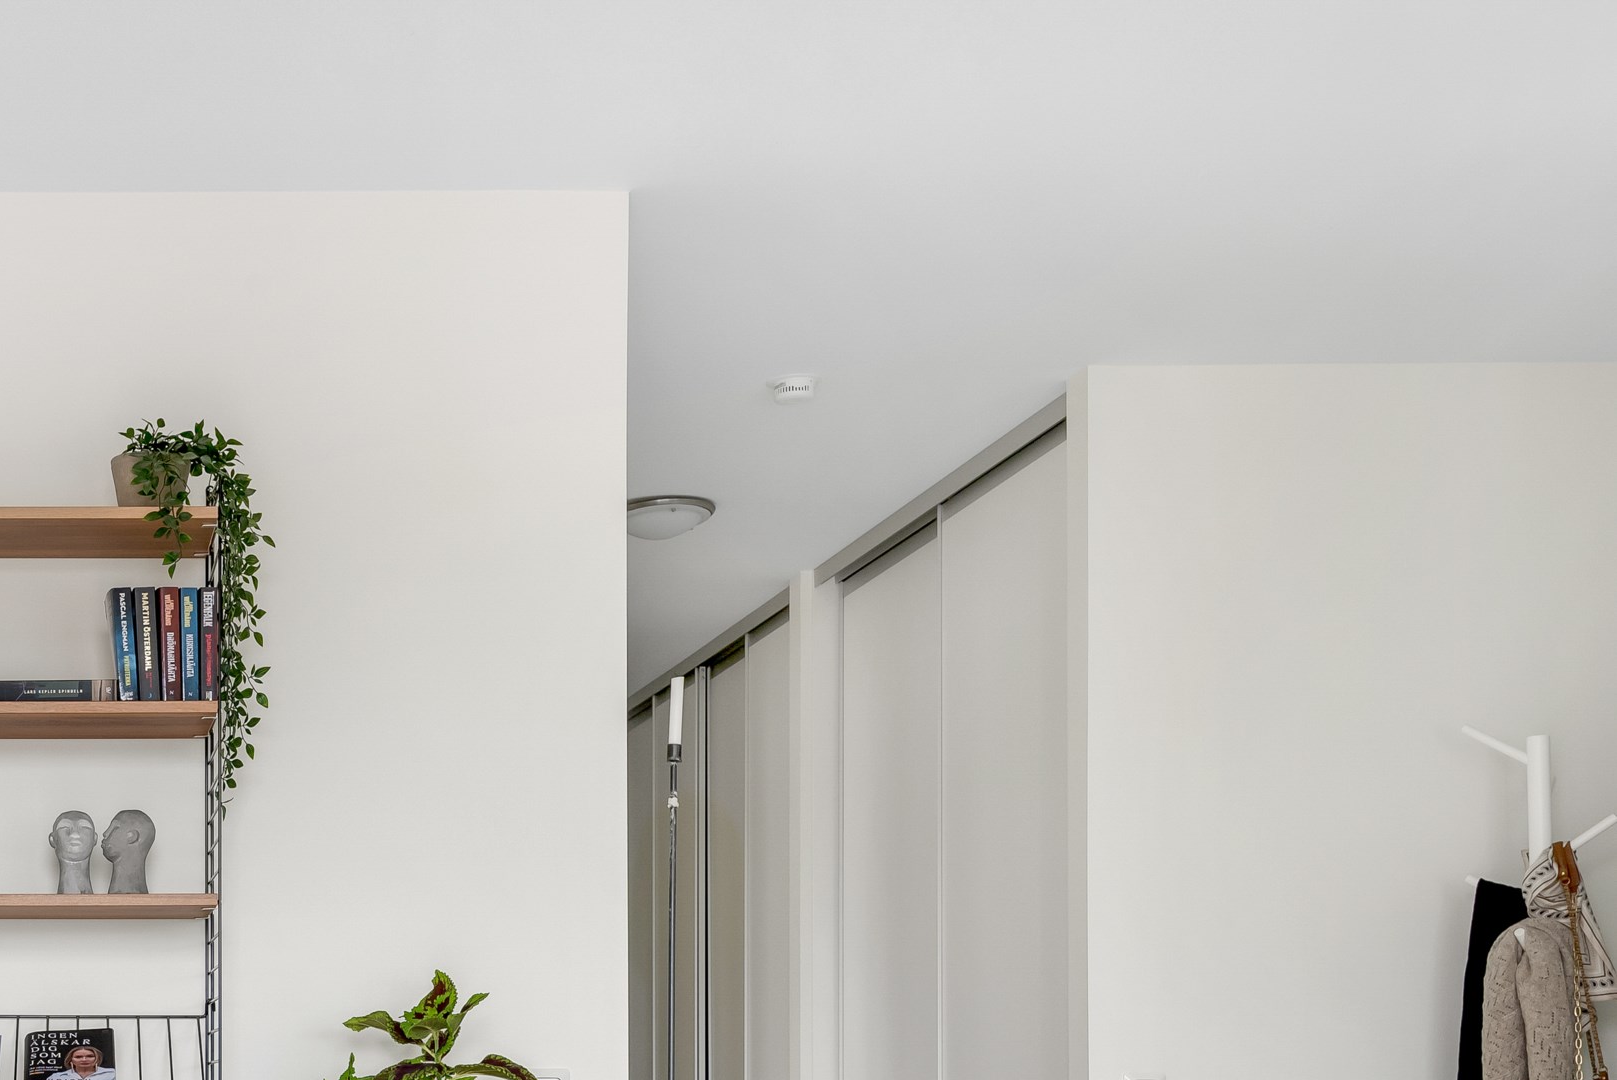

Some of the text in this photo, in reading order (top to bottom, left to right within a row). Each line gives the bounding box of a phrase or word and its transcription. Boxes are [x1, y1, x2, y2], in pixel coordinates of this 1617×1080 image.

[119, 593, 129, 651] PASCAL ENGMAN
[141, 592, 150, 625] MARTIN
[203, 591, 215, 627] TEGENFALK
[143, 626, 152, 671] ÖSTERDAHL
[166, 632, 176, 682] DRÖNARHJÄRTA
[186, 634, 196, 678] KUNGSHJÄRTA
[30, 1038, 91, 1047] ÄLSKAR
[31, 1032, 78, 1040] INGEN
[29, 1059, 57, 1067] JAG
